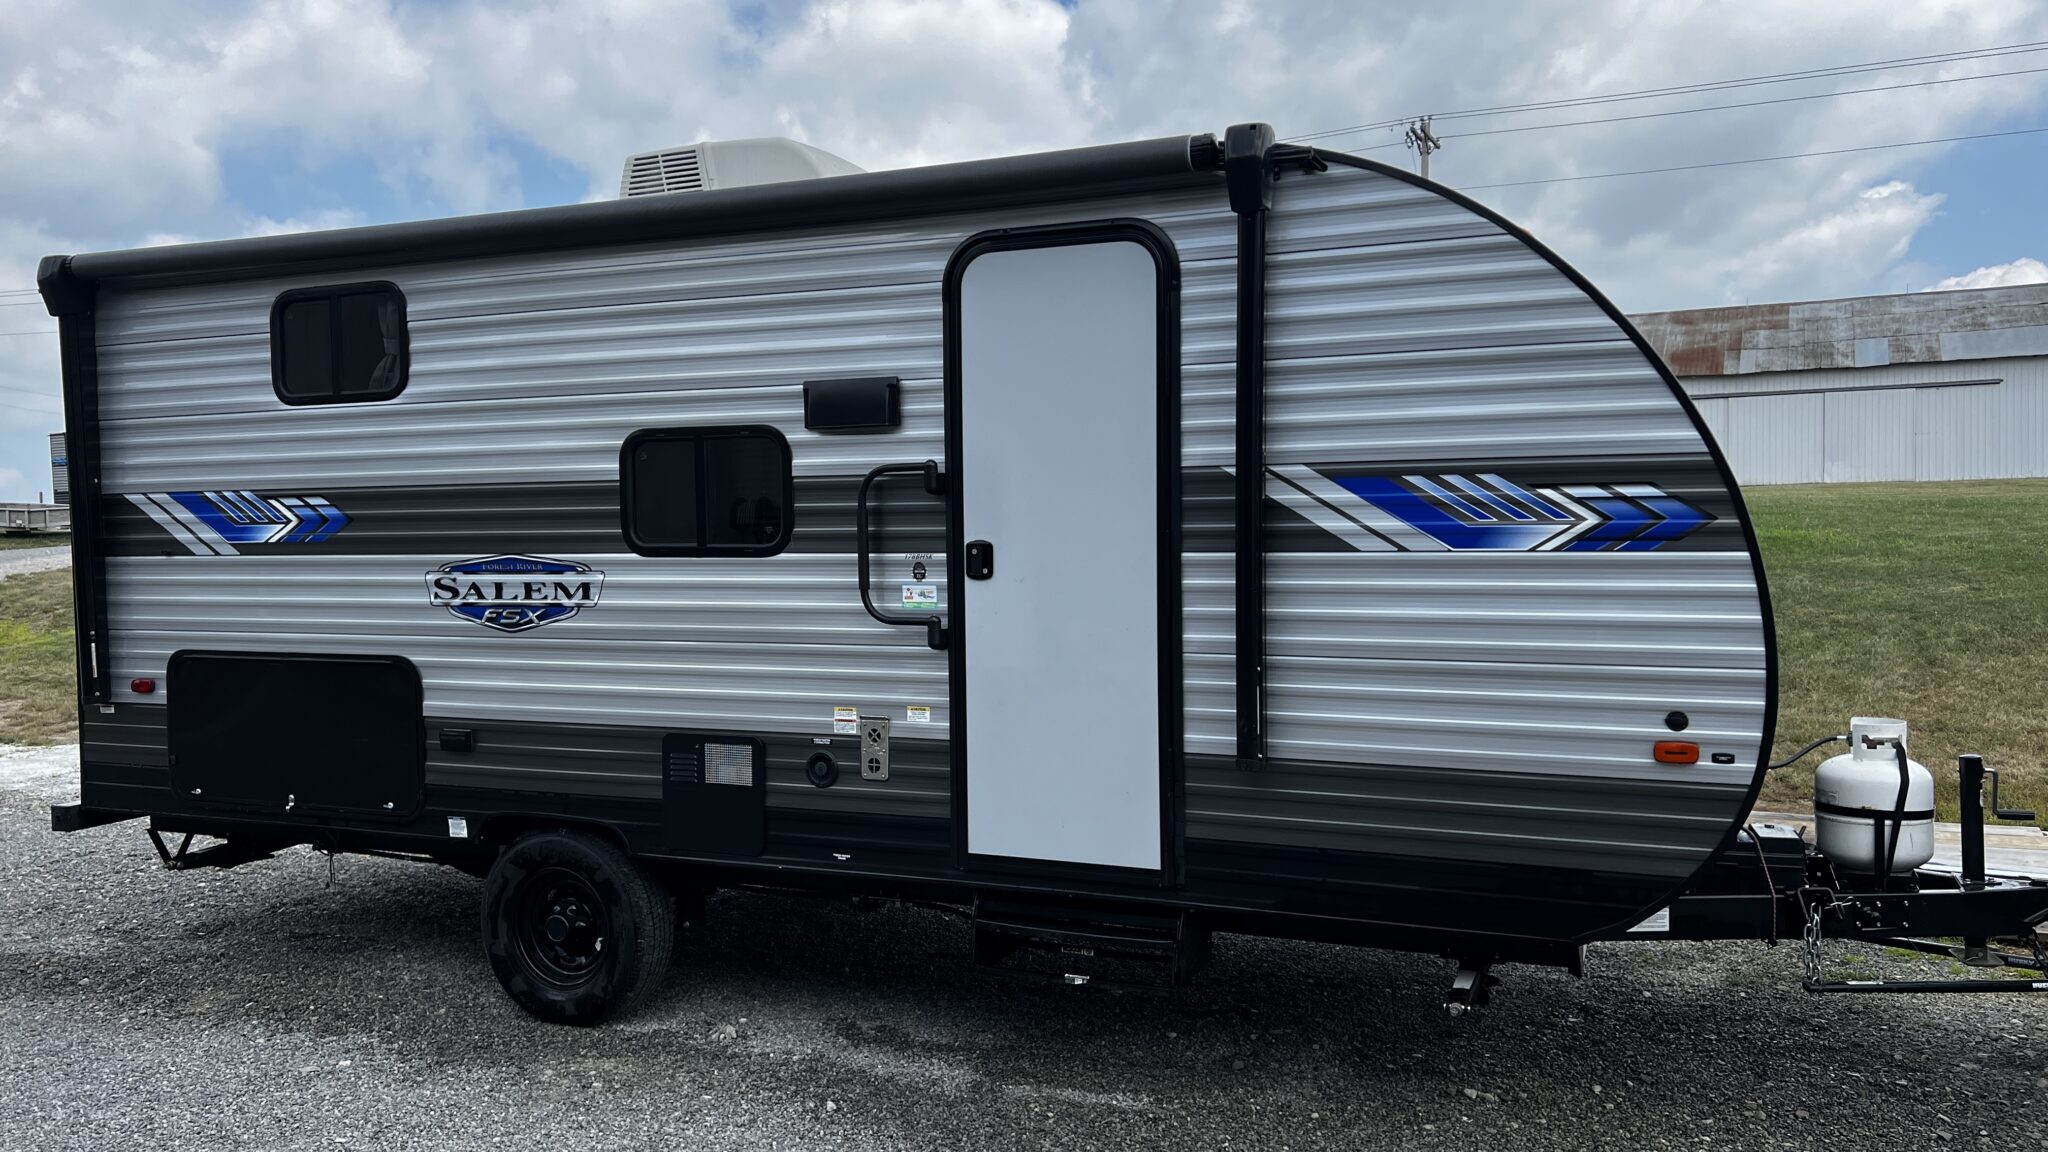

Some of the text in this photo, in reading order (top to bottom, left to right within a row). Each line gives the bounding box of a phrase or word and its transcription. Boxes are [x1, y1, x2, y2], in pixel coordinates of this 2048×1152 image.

[516, 562, 544, 570] RIVER
[433, 576, 594, 601] SALEM
[482, 609, 545, 624] FSX
